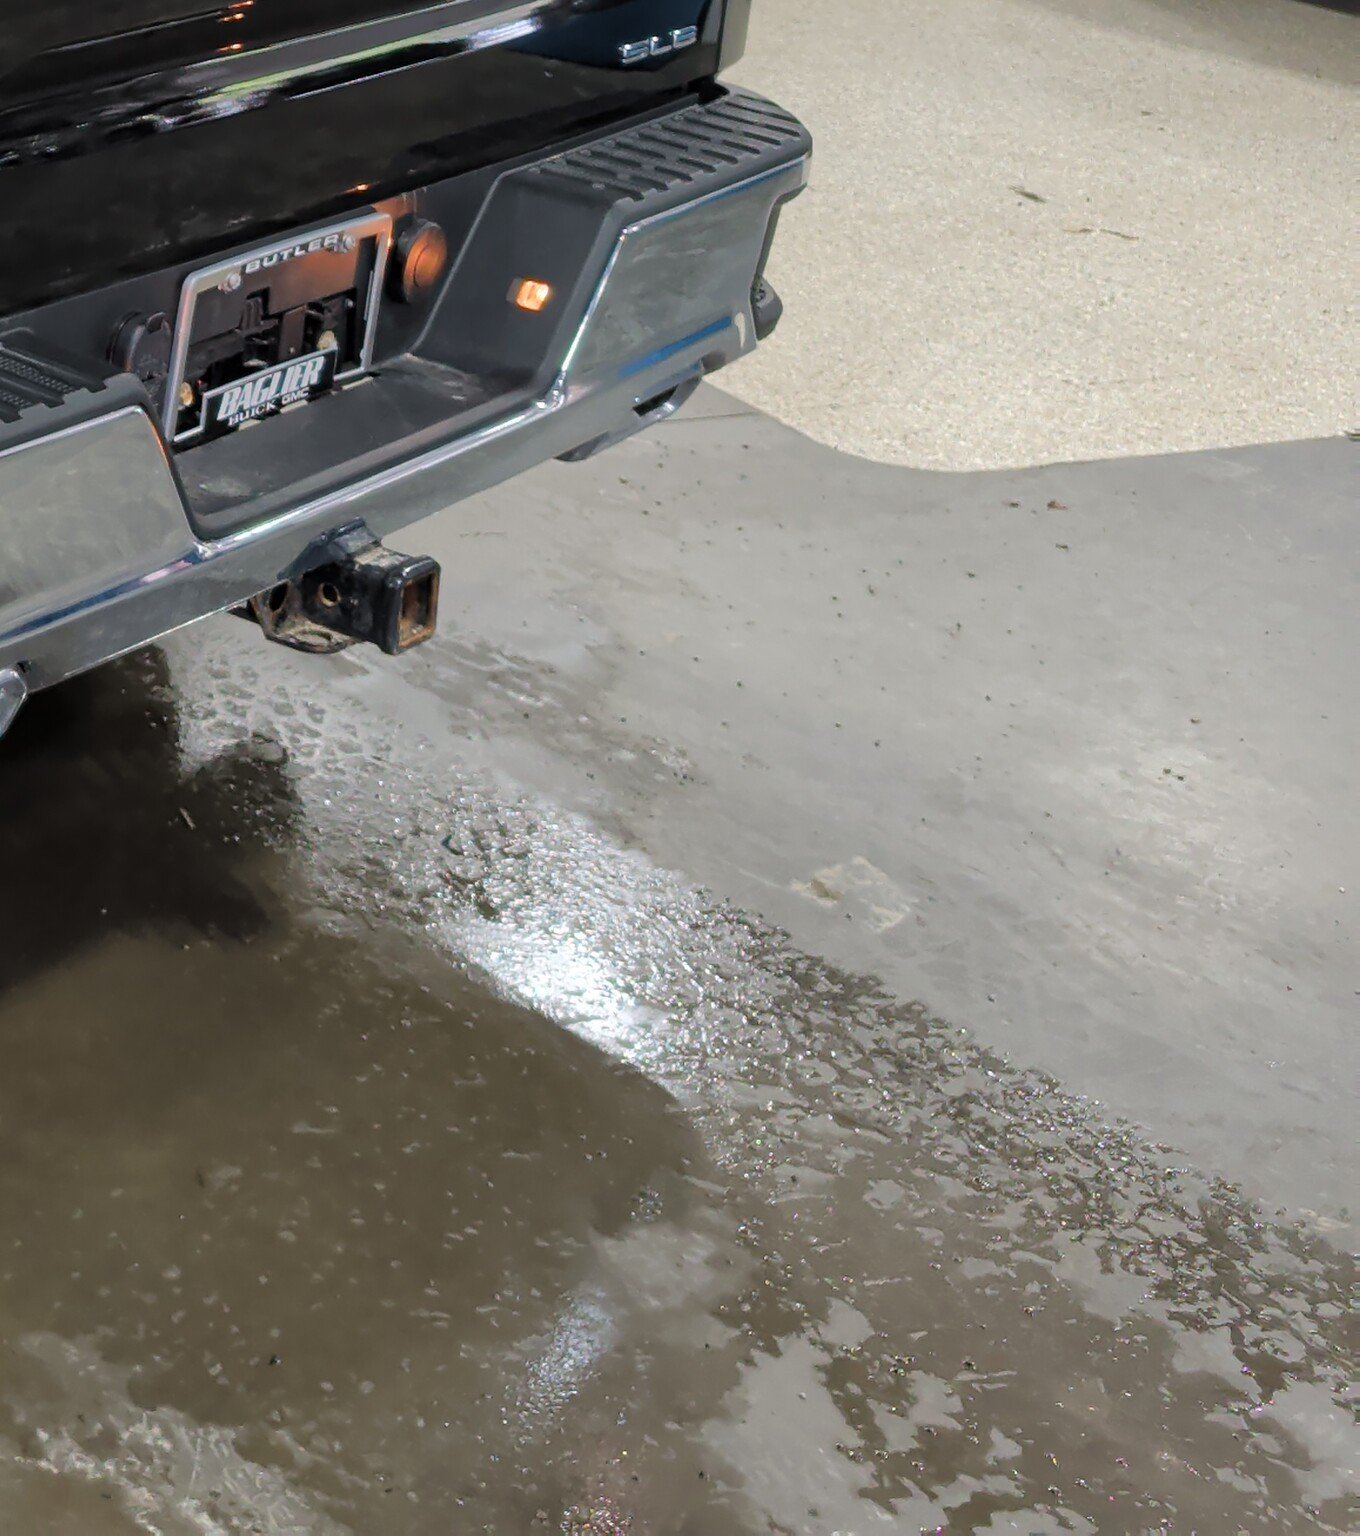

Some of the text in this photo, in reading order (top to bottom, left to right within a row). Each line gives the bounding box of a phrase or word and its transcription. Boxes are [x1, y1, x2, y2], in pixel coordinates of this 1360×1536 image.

[618, 25, 698, 65] SLE
[245, 233, 340, 275] BUTLER
[216, 355, 326, 421] BAGLIER
[281, 386, 310, 405] GMC
